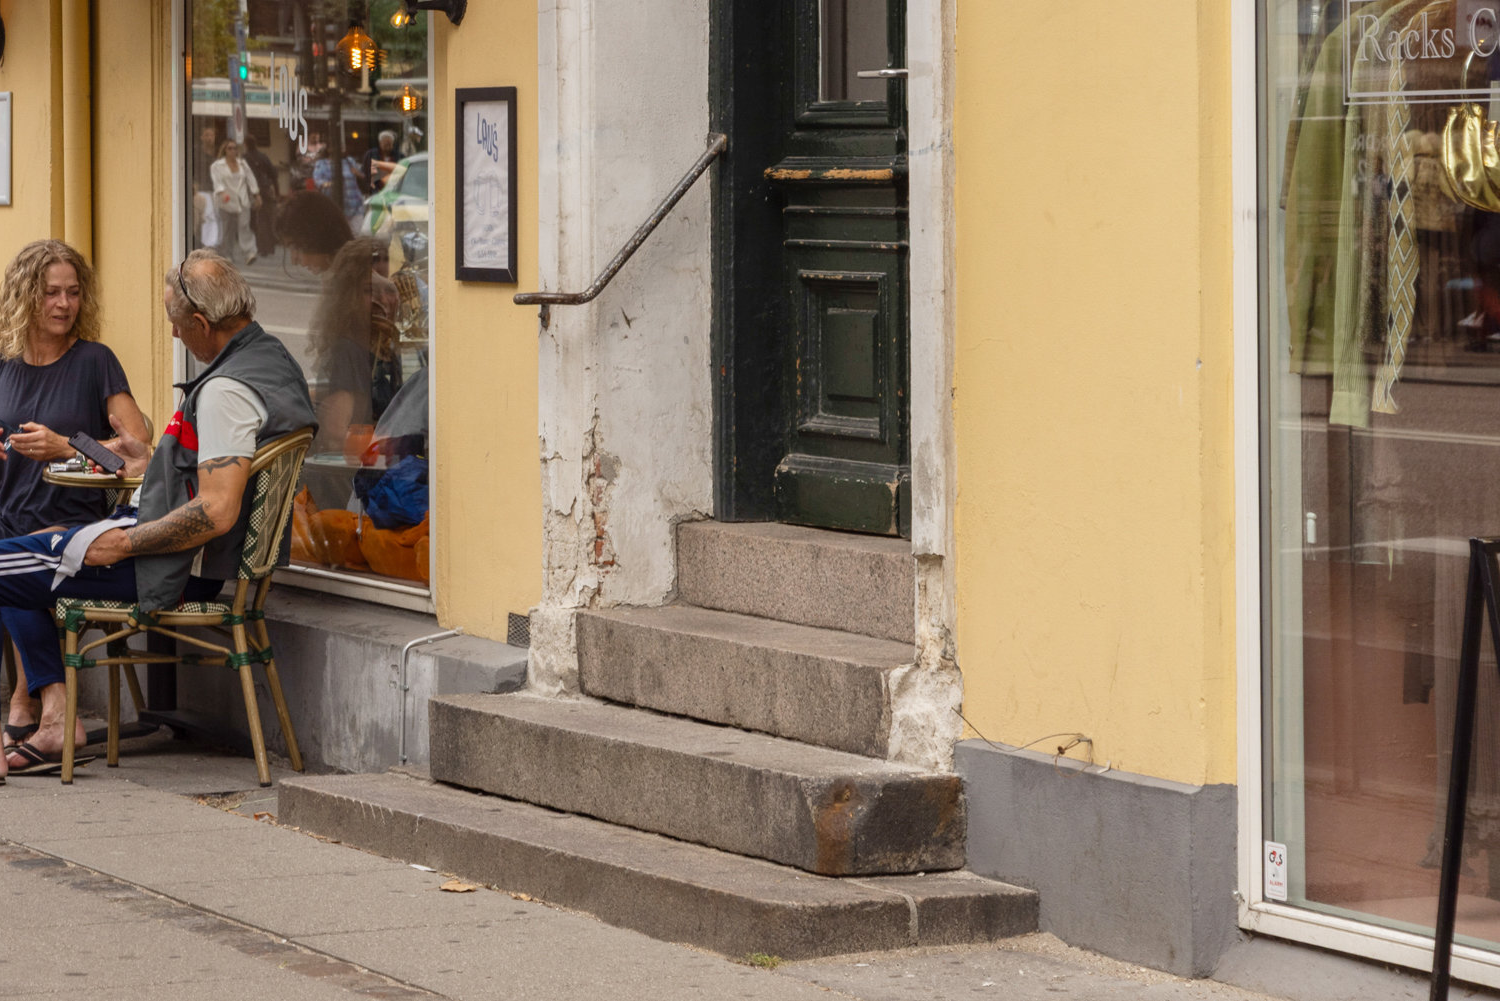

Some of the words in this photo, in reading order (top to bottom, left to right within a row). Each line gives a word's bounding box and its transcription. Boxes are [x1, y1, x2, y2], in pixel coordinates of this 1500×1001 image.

[1357, 11, 1457, 64] Racks
[1468, 7, 1500, 58] C
[270, 51, 308, 155] LAUS
